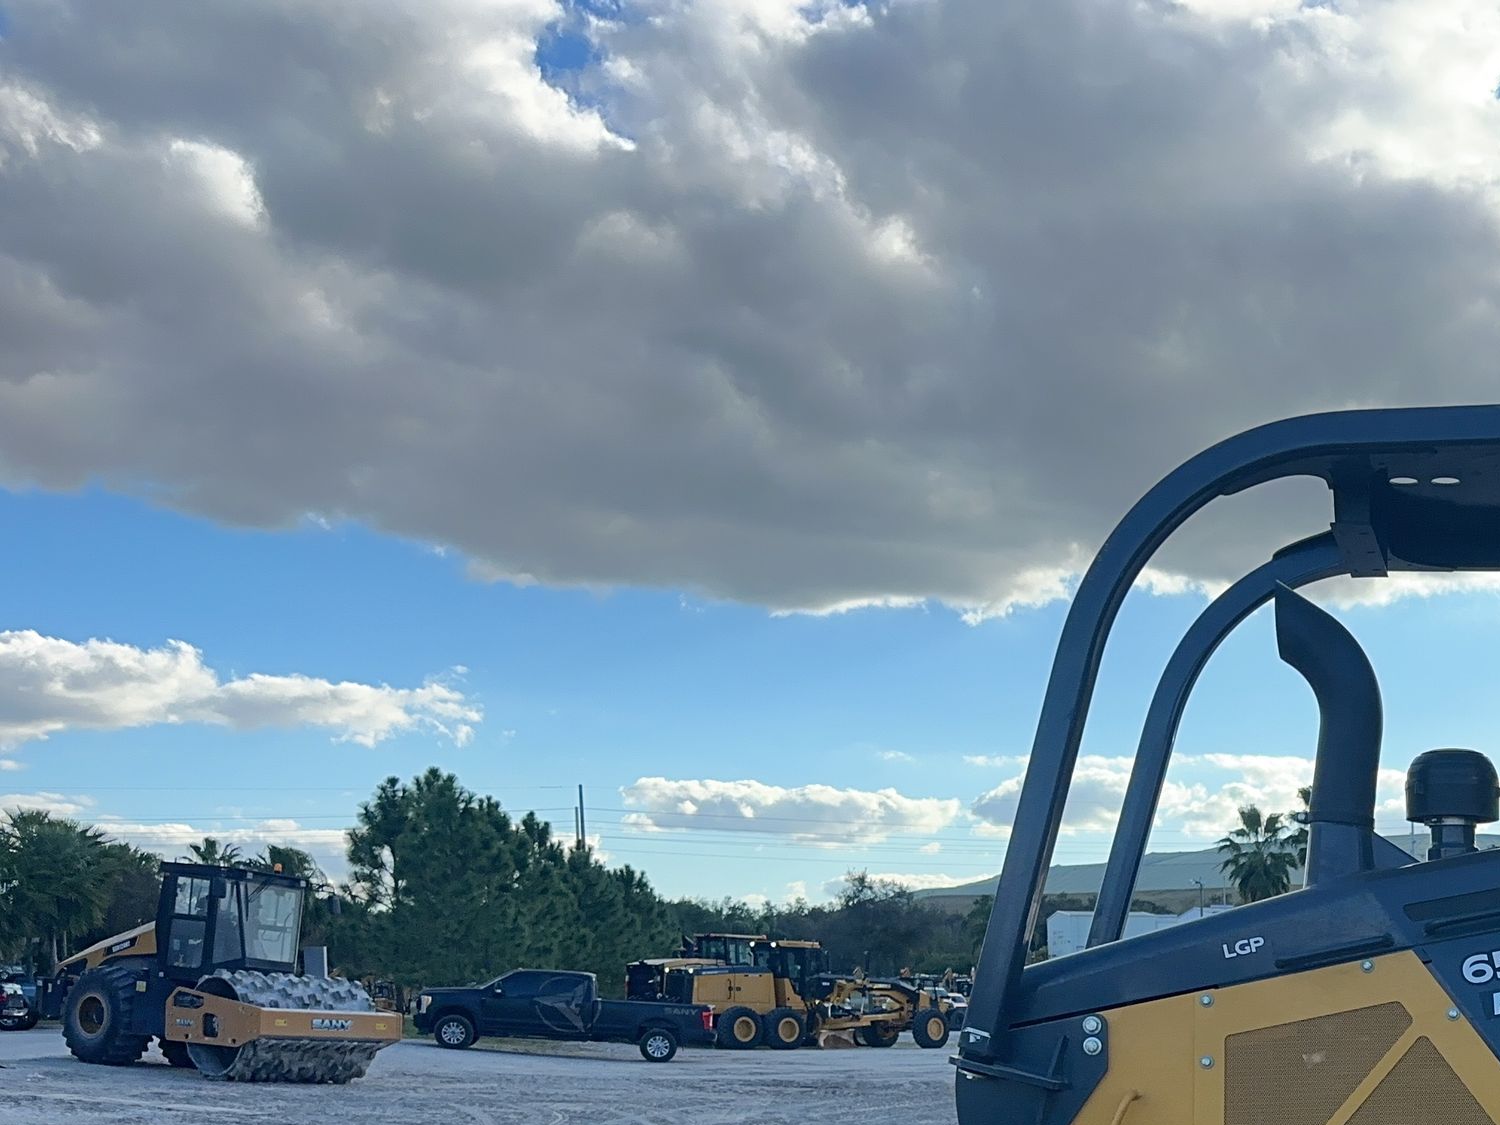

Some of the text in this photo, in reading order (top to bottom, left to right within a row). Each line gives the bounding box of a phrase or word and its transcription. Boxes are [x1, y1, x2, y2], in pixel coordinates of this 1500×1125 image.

[1222, 936, 1265, 959] LGP
[663, 1007, 698, 1016] SANY
[311, 1018, 353, 1031] SANY
